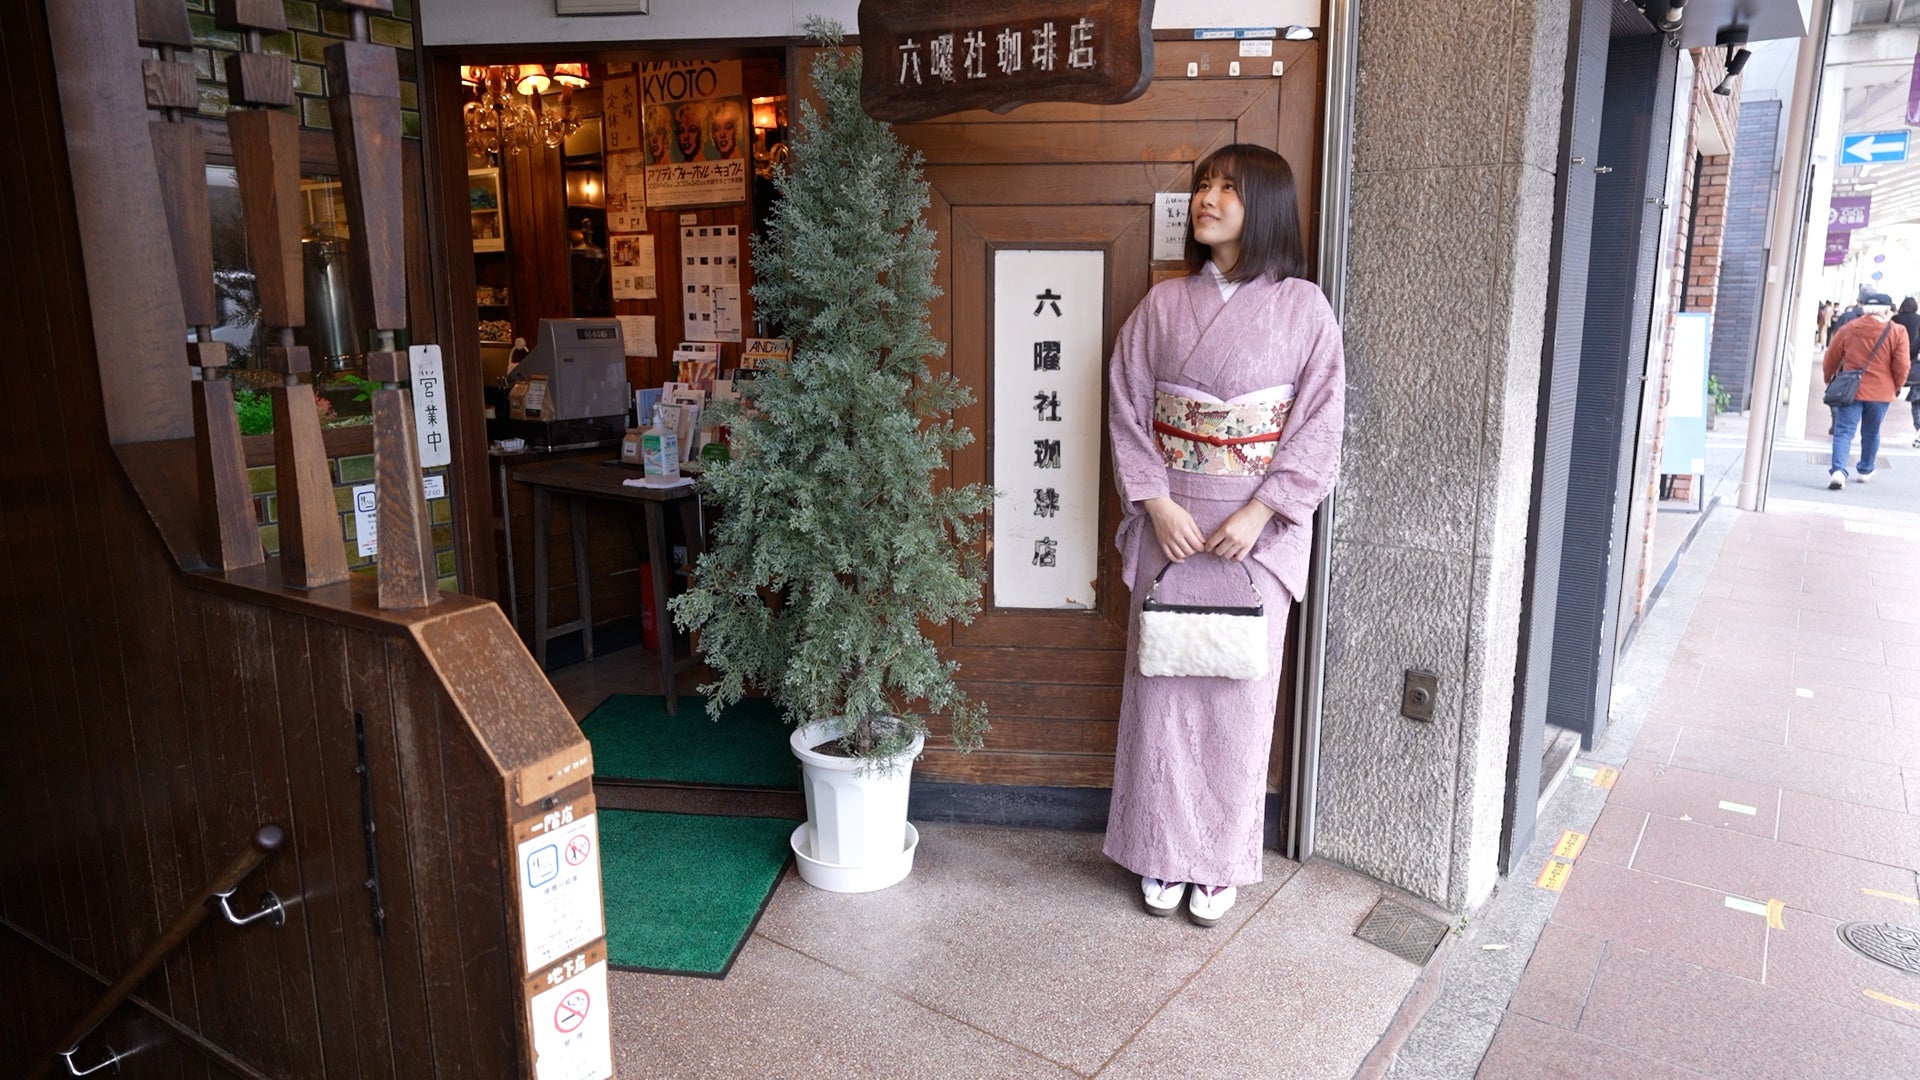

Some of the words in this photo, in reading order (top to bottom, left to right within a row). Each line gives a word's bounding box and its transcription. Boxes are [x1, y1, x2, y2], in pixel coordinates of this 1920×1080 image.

[899, 18, 1096, 85] 六曜社珈琲店
[642, 67, 717, 104] KYOTO
[420, 370, 442, 453] 営業中
[1032, 288, 1063, 568] 六曜社珈琲店
[547, 953, 587, 985] 地下店
